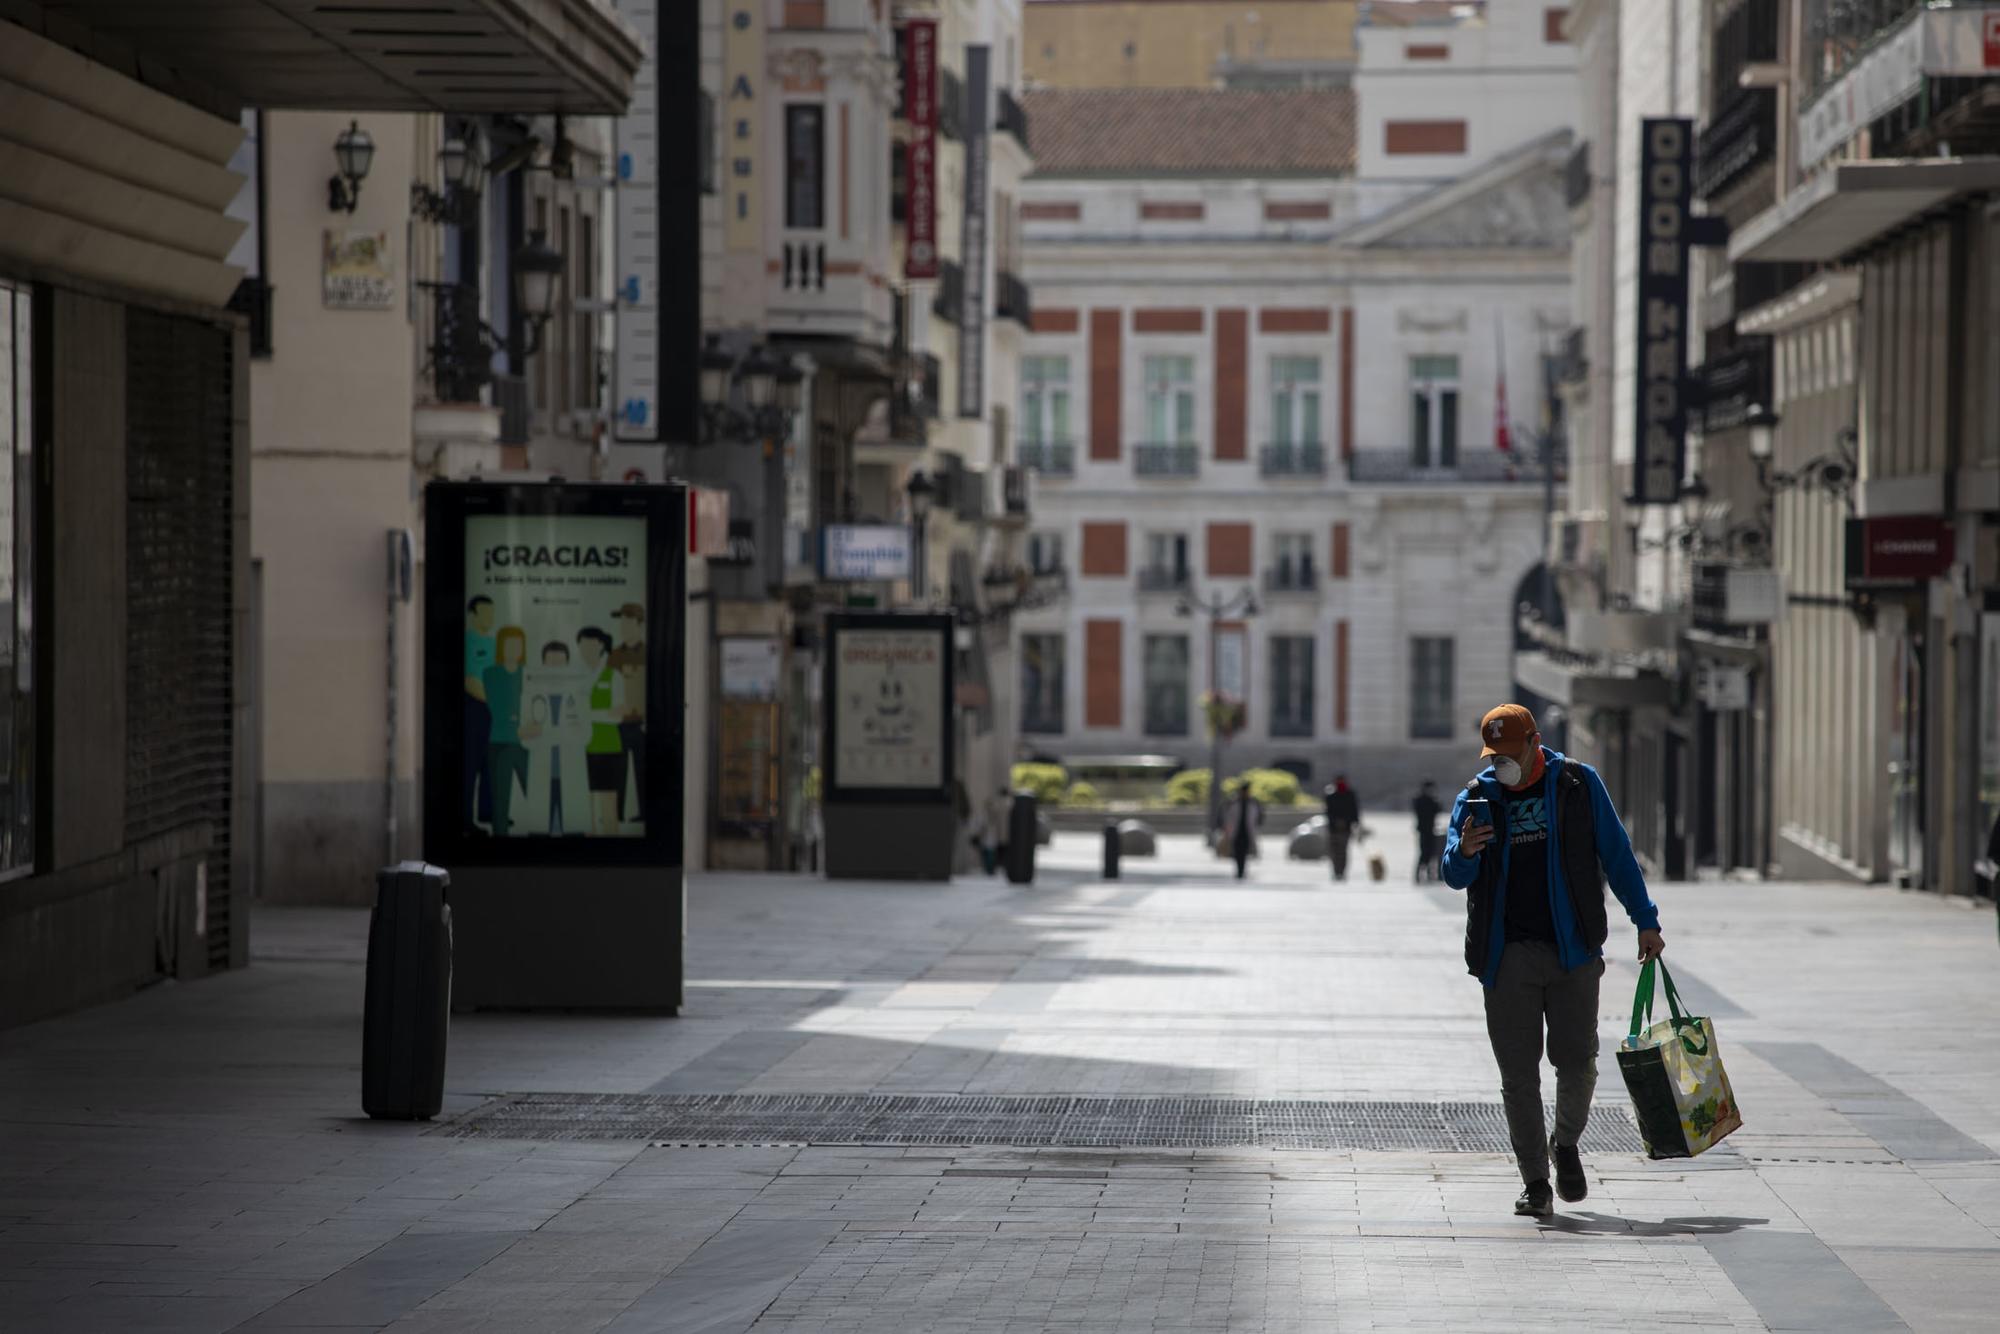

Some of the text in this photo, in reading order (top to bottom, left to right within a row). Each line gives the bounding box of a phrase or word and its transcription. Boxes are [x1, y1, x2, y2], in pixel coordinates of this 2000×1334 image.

[913, 25, 932, 237] PETIT PALACE
[1643, 122, 1683, 500] SPORT 2000
[484, 545, 629, 571] ¡GRACIAS!
[1489, 719, 1504, 738] T
